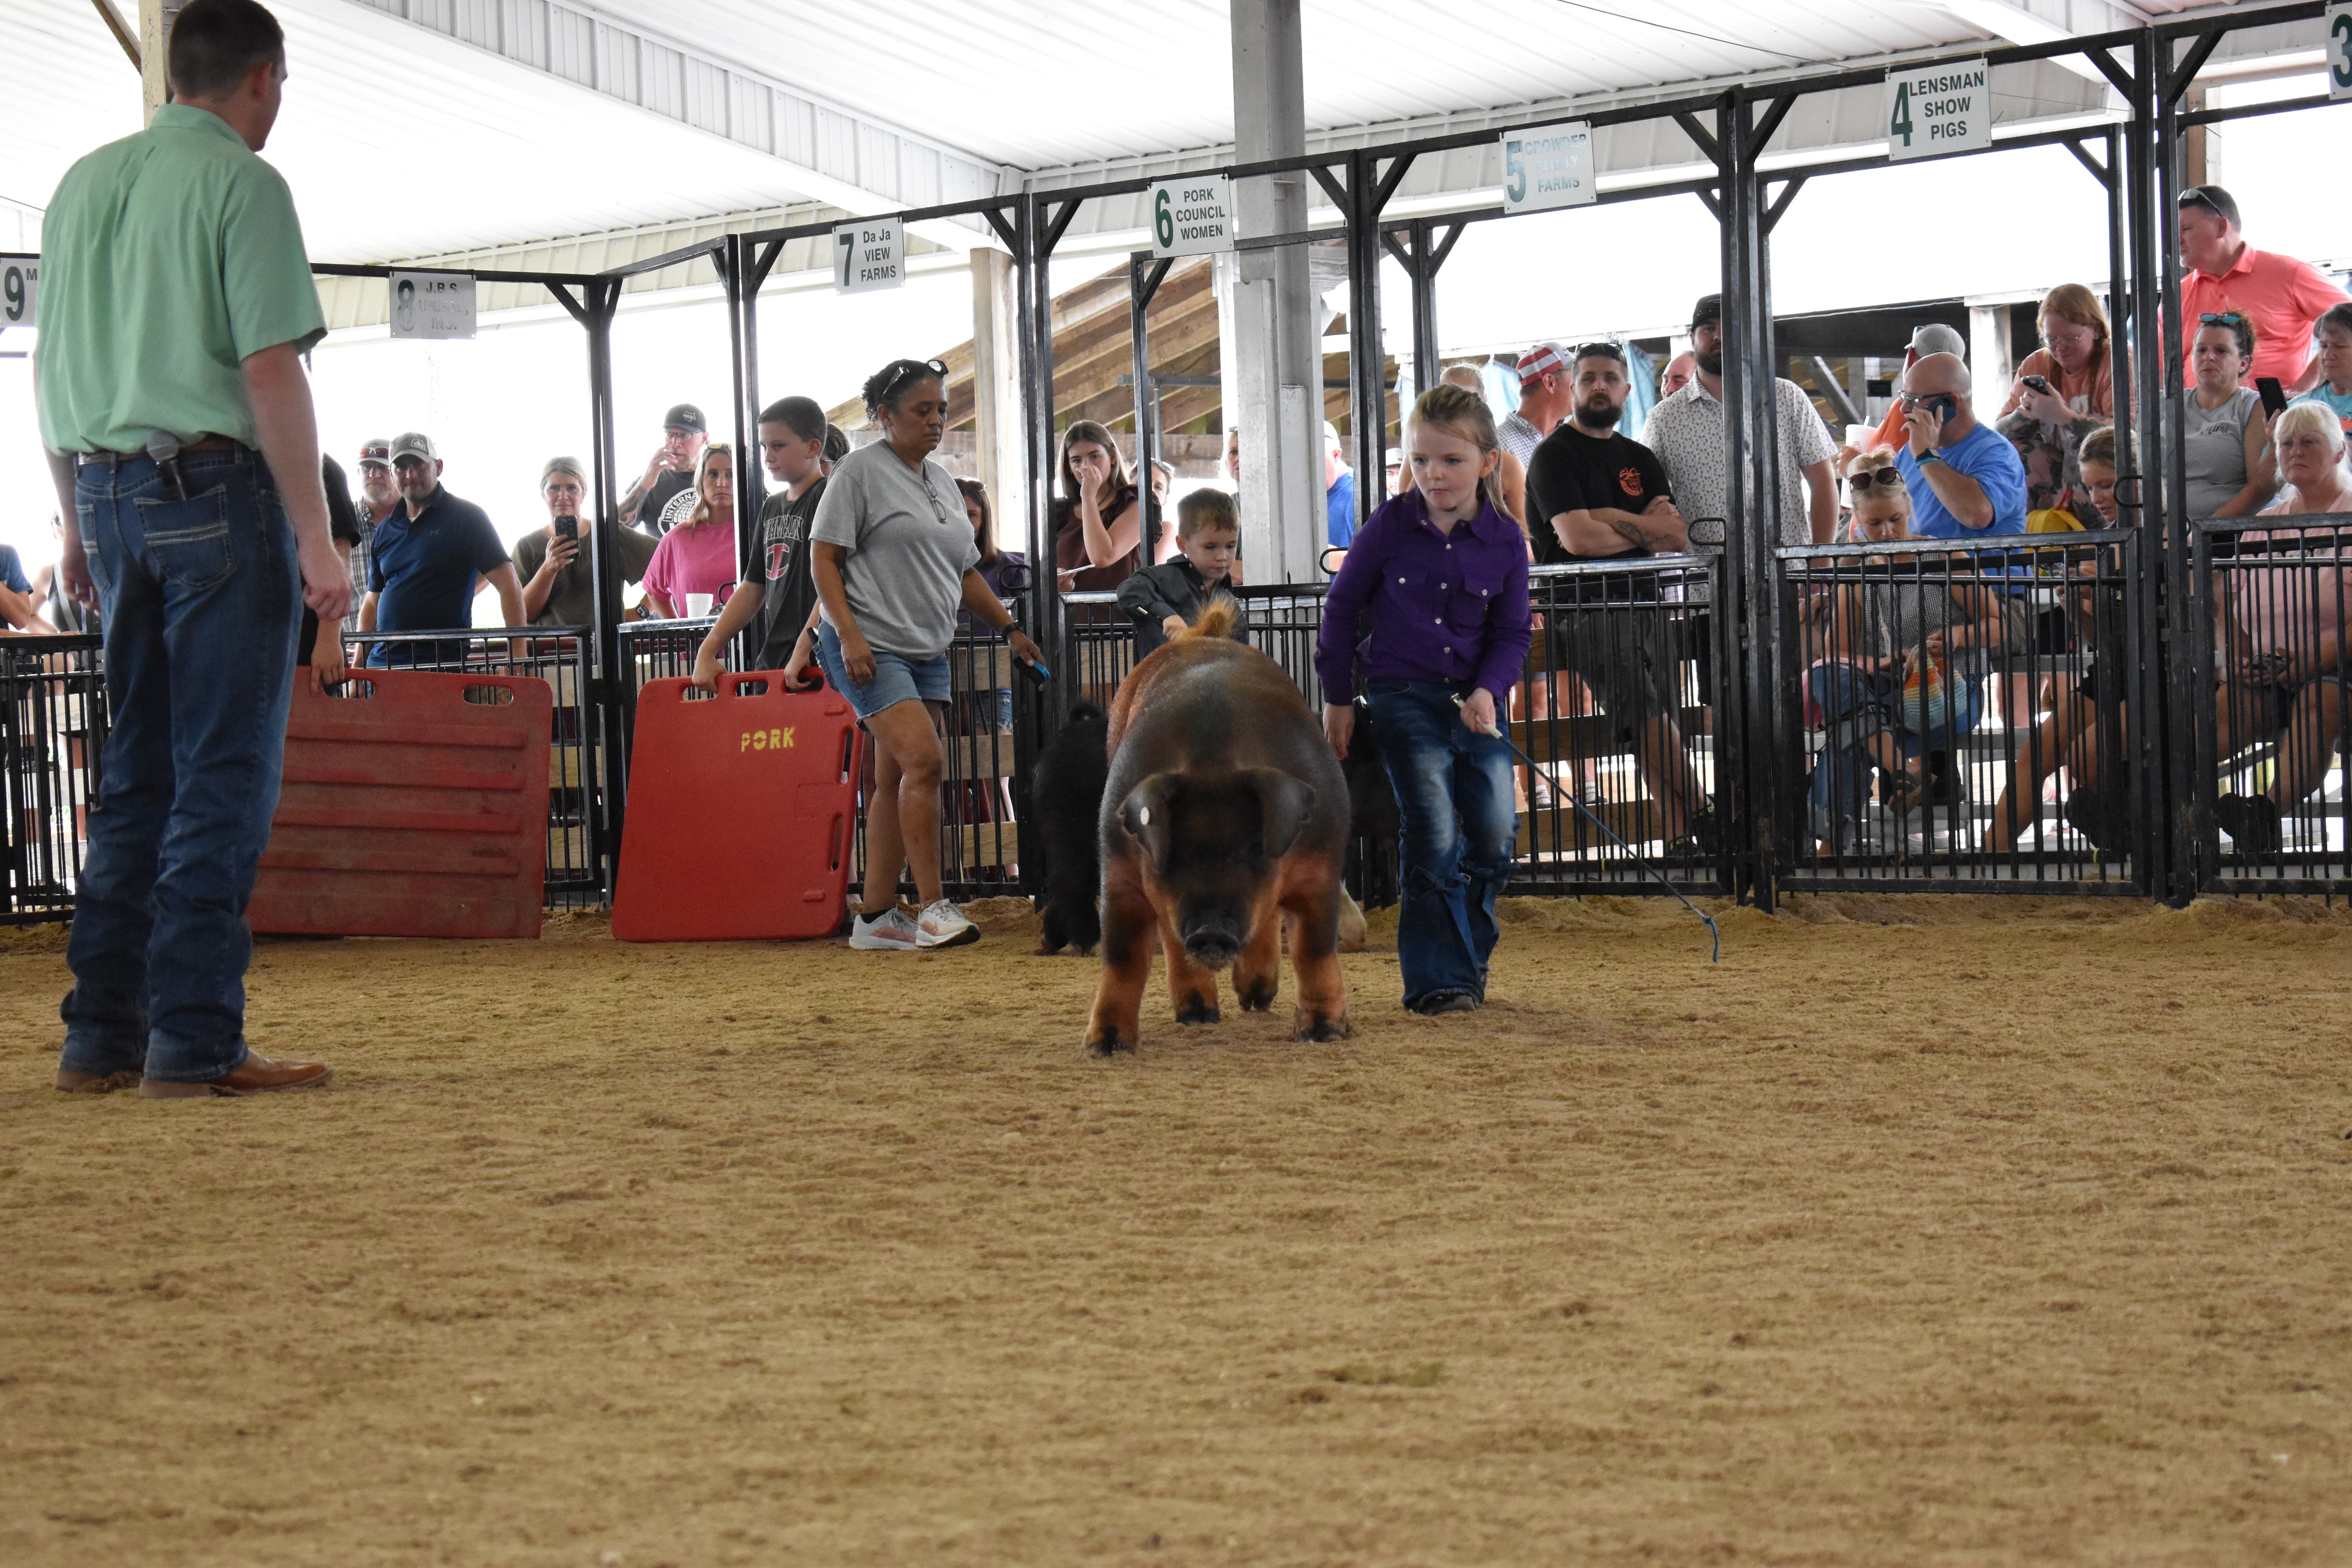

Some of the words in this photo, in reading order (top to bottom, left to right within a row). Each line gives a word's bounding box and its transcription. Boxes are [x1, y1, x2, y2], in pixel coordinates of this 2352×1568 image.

[2331, 13, 2352, 88] 3
[1909, 71, 1984, 97] LENSMAN
[1891, 81, 1913, 147] 4
[1924, 96, 1970, 118] SHOW
[1931, 121, 1967, 140] PIGS
[1506, 140, 1526, 203] 5
[1183, 188, 1214, 203] PORK
[1537, 176, 1580, 192] FARMS
[1155, 189, 1174, 248] 6
[1176, 206, 1225, 222] COUNCIL
[863, 231, 876, 243] Da
[879, 228, 891, 241] Ja
[1180, 224, 1223, 239] WOMEN
[839, 233, 854, 287] 7
[864, 247, 891, 262] VIEW
[861, 265, 896, 282] FARMS
[4, 266, 25, 322] 9
[398, 279, 415, 331] 8
[741, 726, 795, 752] PORK
